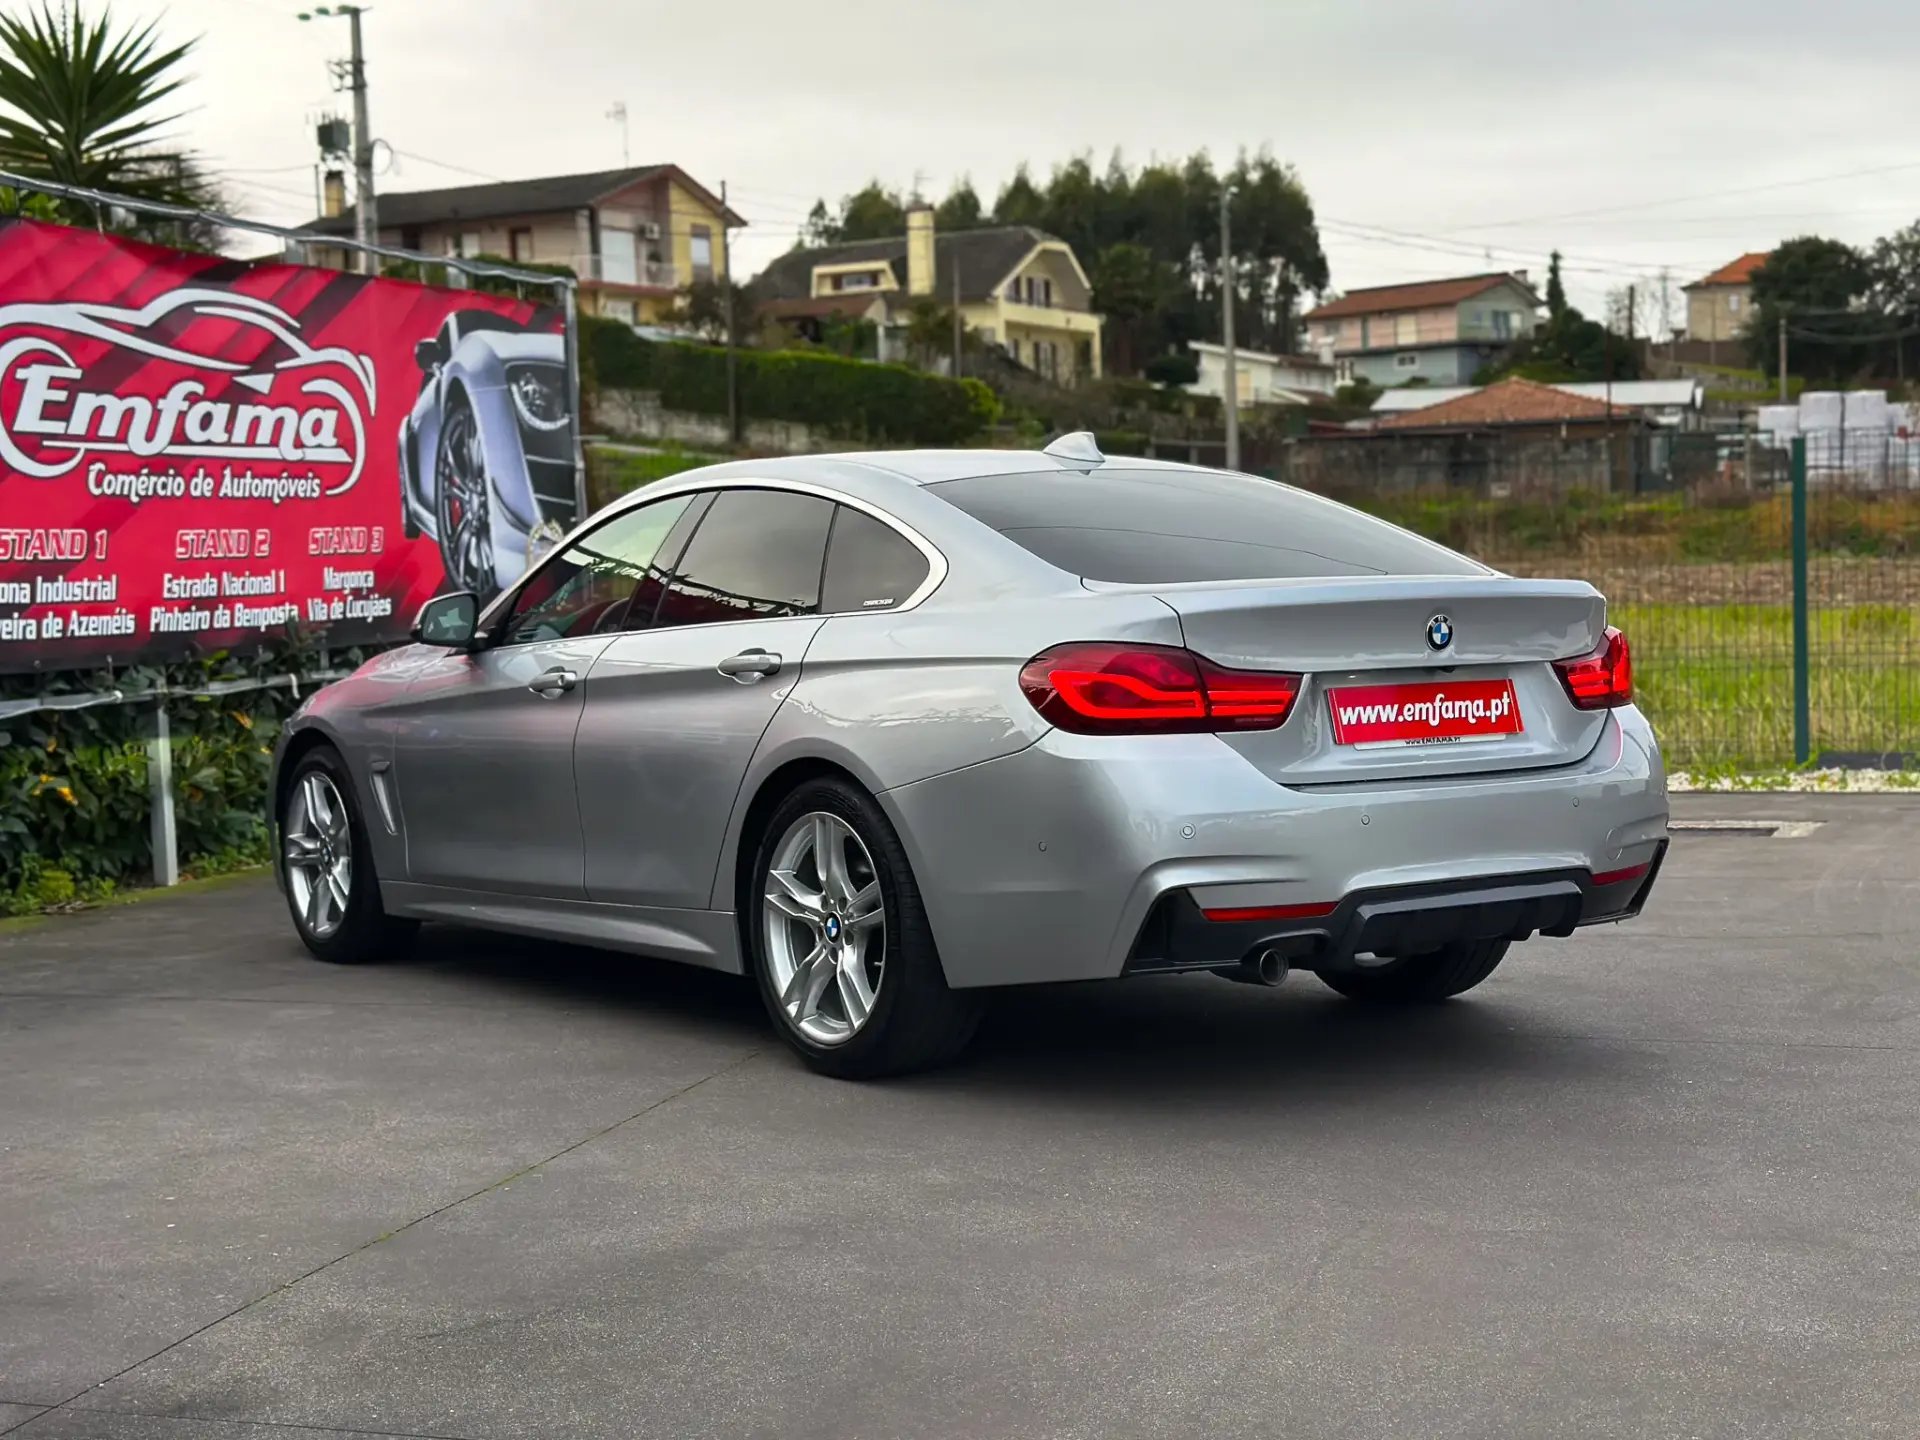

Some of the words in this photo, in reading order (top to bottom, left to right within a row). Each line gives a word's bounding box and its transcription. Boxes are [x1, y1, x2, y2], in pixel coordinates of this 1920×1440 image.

[13, 364, 339, 461] Emfama
[88, 462, 185, 502] Comércio
[190, 469, 214, 498] de
[219, 466, 321, 503] Automóveis
[0, 529, 88, 560] STAND
[95, 529, 108, 560] 1
[176, 529, 250, 558] STAND
[254, 529, 271, 557] 2
[308, 527, 367, 555] STAND
[371, 526, 384, 553] 3
[36, 574, 117, 602] Industrial
[163, 572, 218, 599] Estrada
[222, 570, 276, 596] Nacional
[279, 569, 286, 592] 1
[0, 612, 37, 640] eira
[41, 611, 63, 639] de
[67, 607, 135, 637] Azeméis
[150, 605, 210, 632] Pinheiro
[213, 603, 231, 629] da
[234, 601, 299, 632] Bemposta
[307, 597, 328, 622] Vila
[330, 596, 344, 619] de
[1339, 691, 1510, 727] www.emfama.pt
